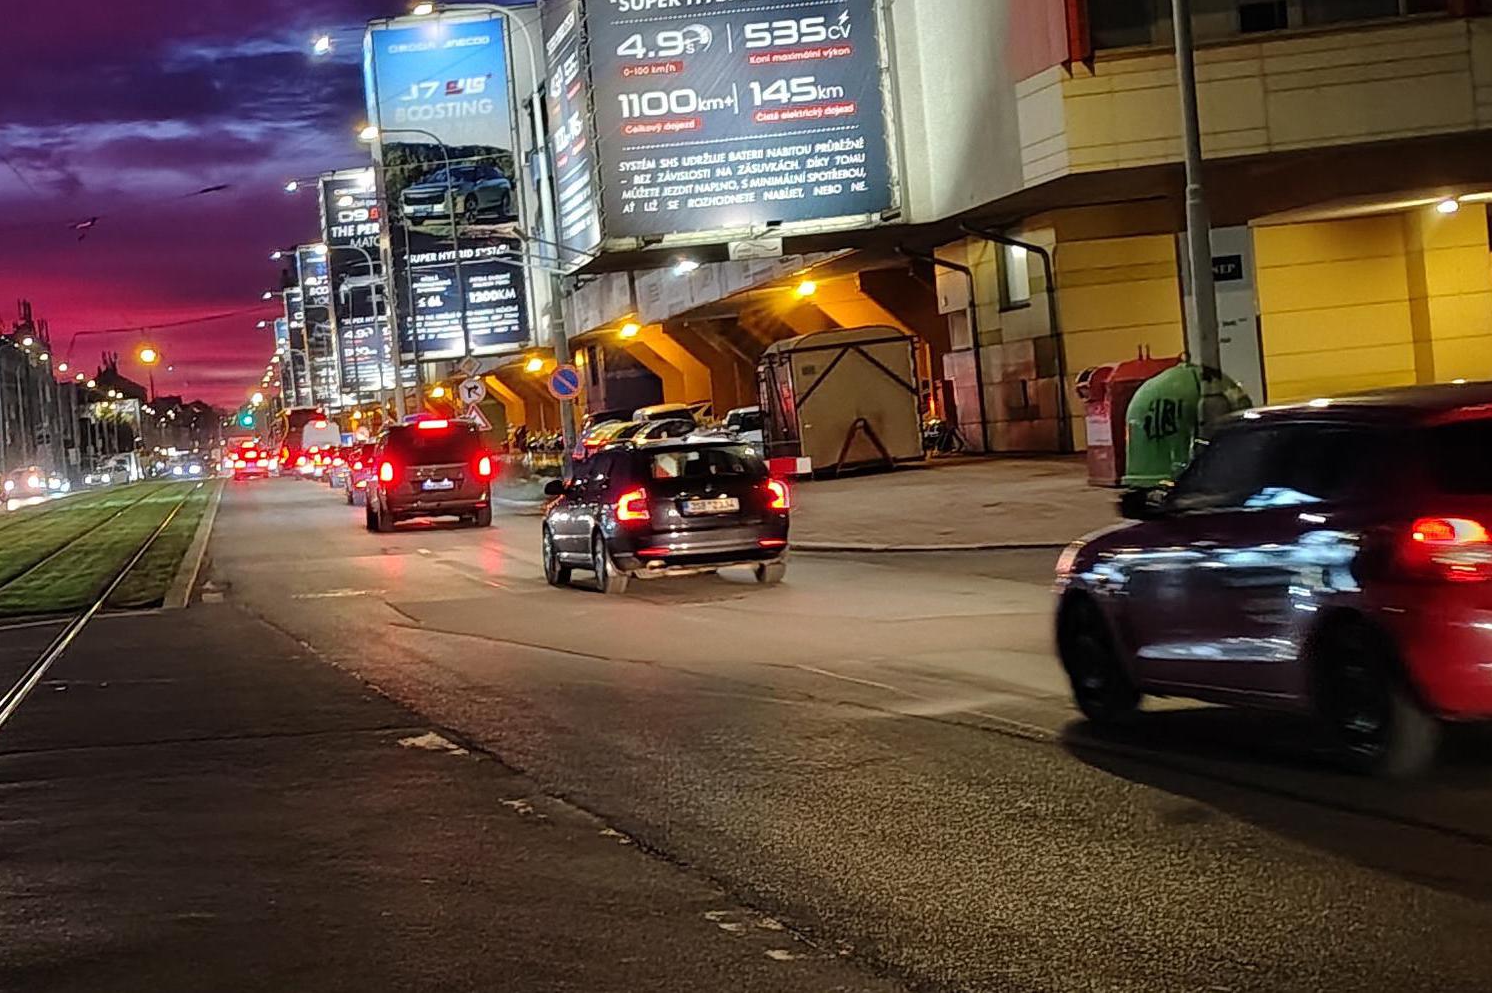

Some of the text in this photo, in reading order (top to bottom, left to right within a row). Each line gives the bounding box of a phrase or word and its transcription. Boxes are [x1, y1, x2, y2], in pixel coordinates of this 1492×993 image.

[399, 80, 440, 101] J7
[395, 98, 493, 123] BOOSTING
[715, 166, 733, 178] NA
[835, 153, 866, 166] TOMU
[661, 184, 693, 197] JEZDIT
[667, 199, 680, 210] SE
[813, 183, 843, 196] NEBO
[338, 208, 369, 223] 09
[331, 222, 381, 238] THE PER
[350, 235, 381, 247] MATC
